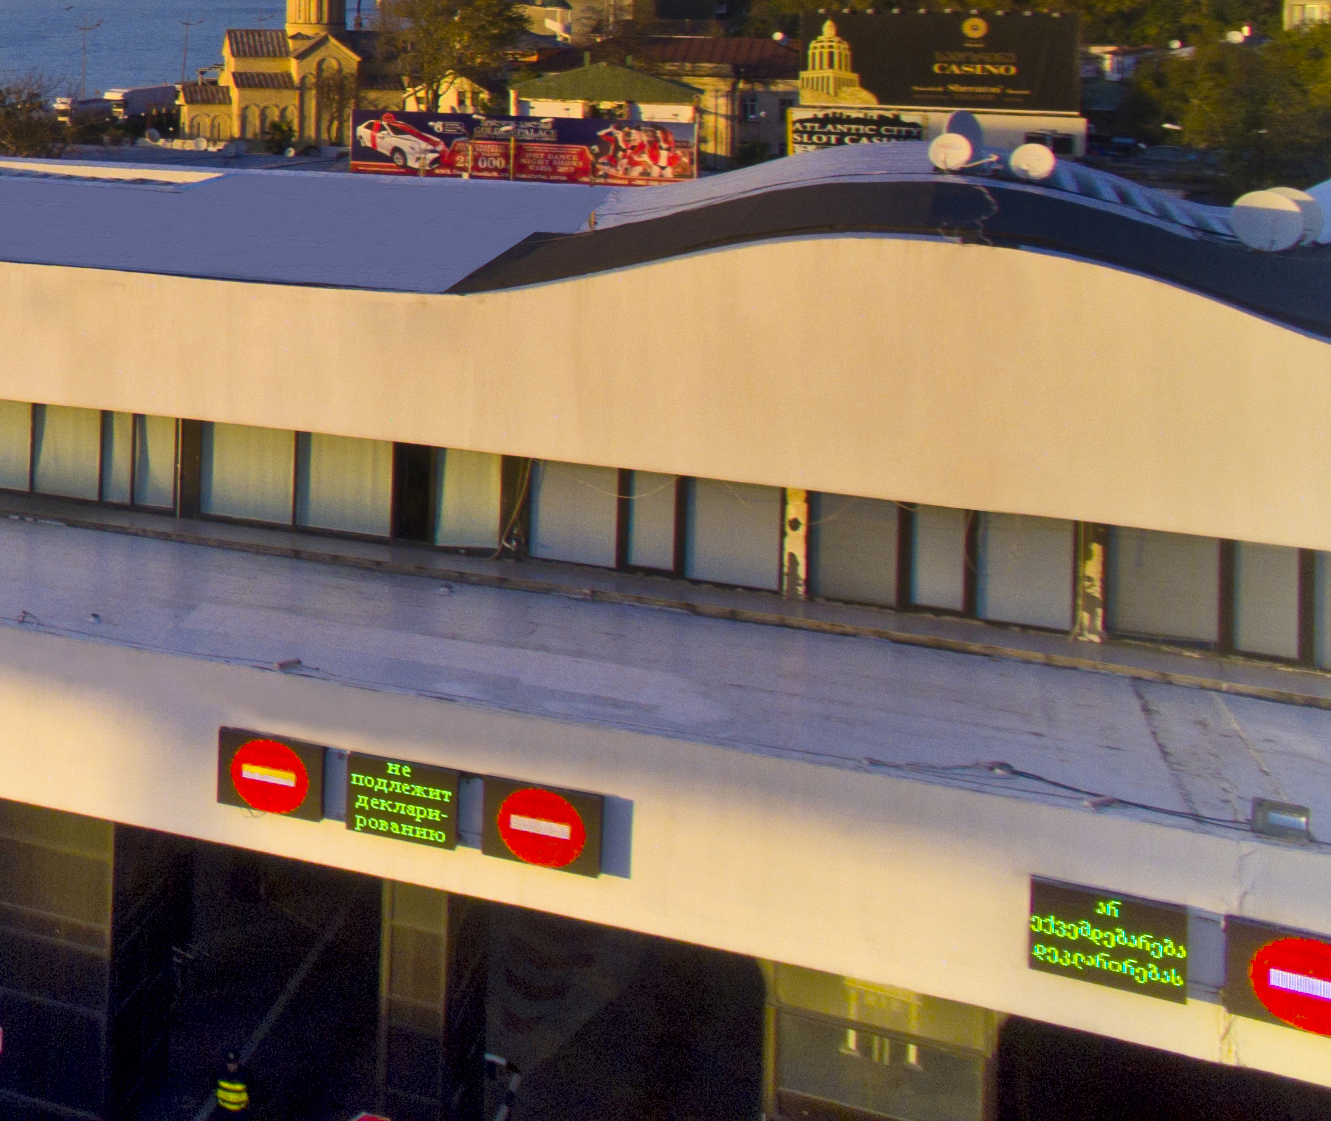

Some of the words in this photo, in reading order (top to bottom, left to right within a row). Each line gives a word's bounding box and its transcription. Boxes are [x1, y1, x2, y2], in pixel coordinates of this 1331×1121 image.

[933, 63, 1018, 75] CASINO
[793, 122, 879, 135] ATLANTIC
[881, 126, 922, 135] CITY
[793, 134, 840, 145] SLOT
[386, 762, 412, 778] не
[350, 773, 452, 803] подлежит
[355, 794, 449, 823] деклари-
[355, 814, 447, 843] рованию
[1095, 900, 1122, 918] არ
